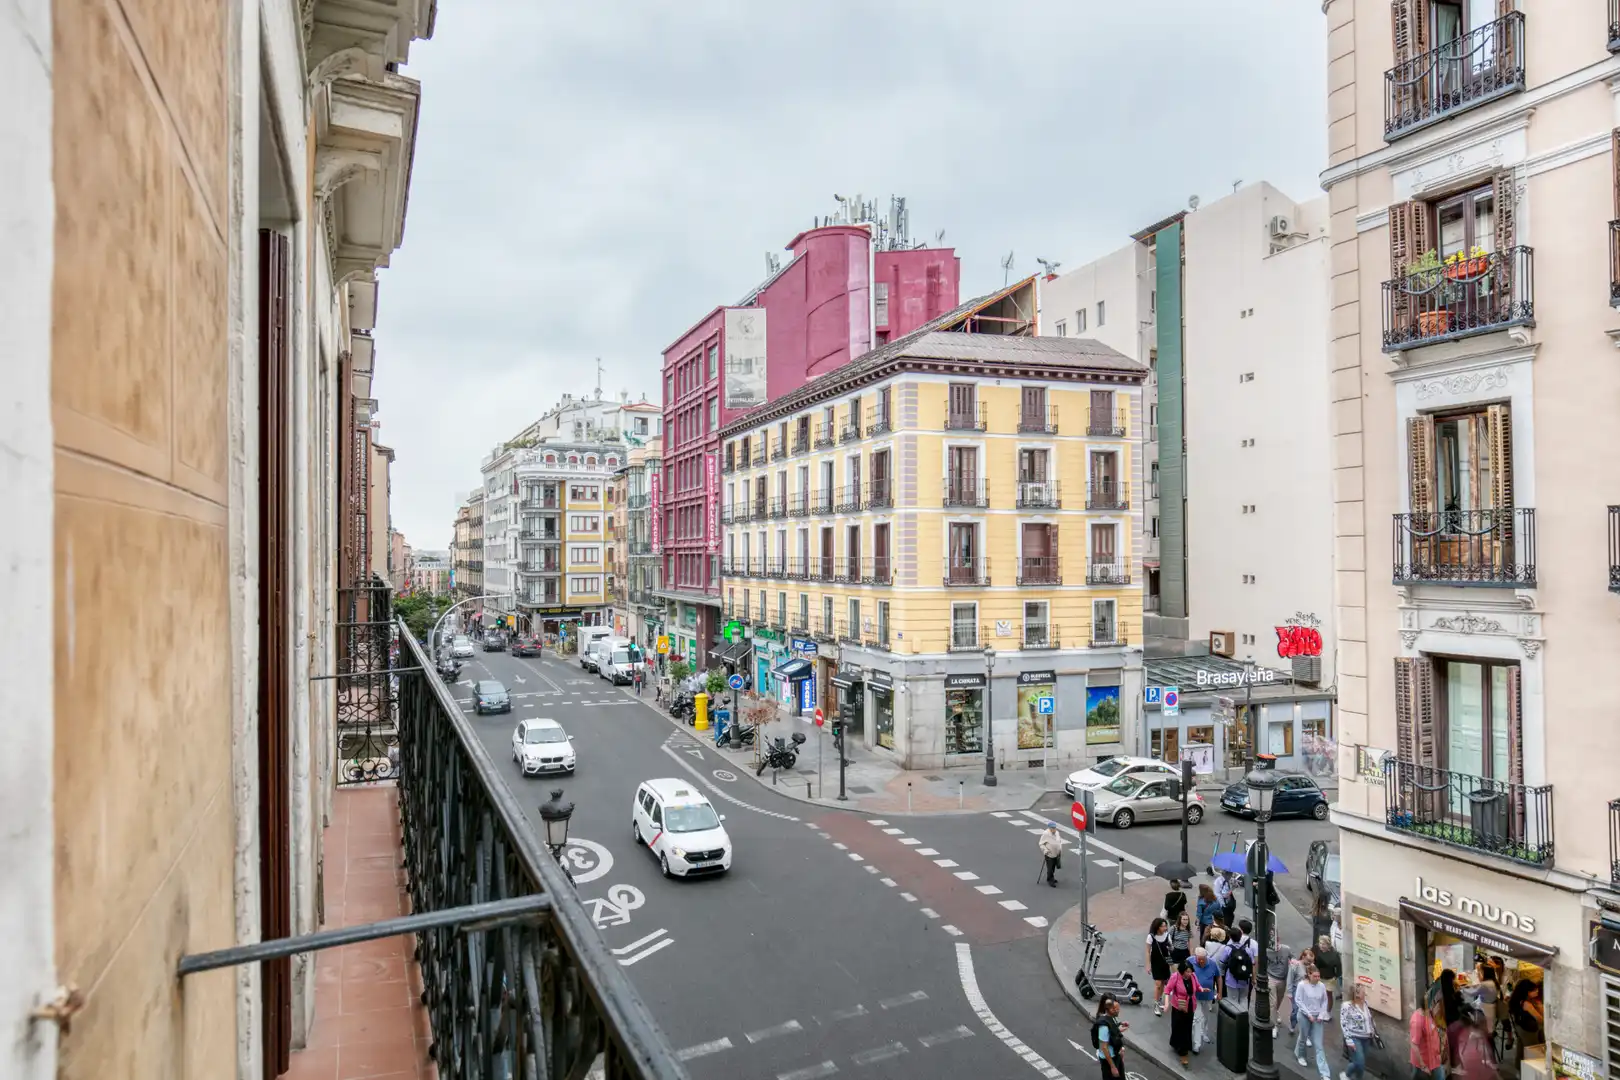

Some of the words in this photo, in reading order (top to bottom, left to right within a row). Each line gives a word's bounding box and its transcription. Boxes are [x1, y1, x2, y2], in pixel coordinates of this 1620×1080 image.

[1040, 698, 1050, 712] P
[1415, 876, 1452, 906] las
[1457, 896, 1536, 934] muns
[1433, 920, 1443, 929] THE
[1480, 936, 1510, 952] EMPANADA
